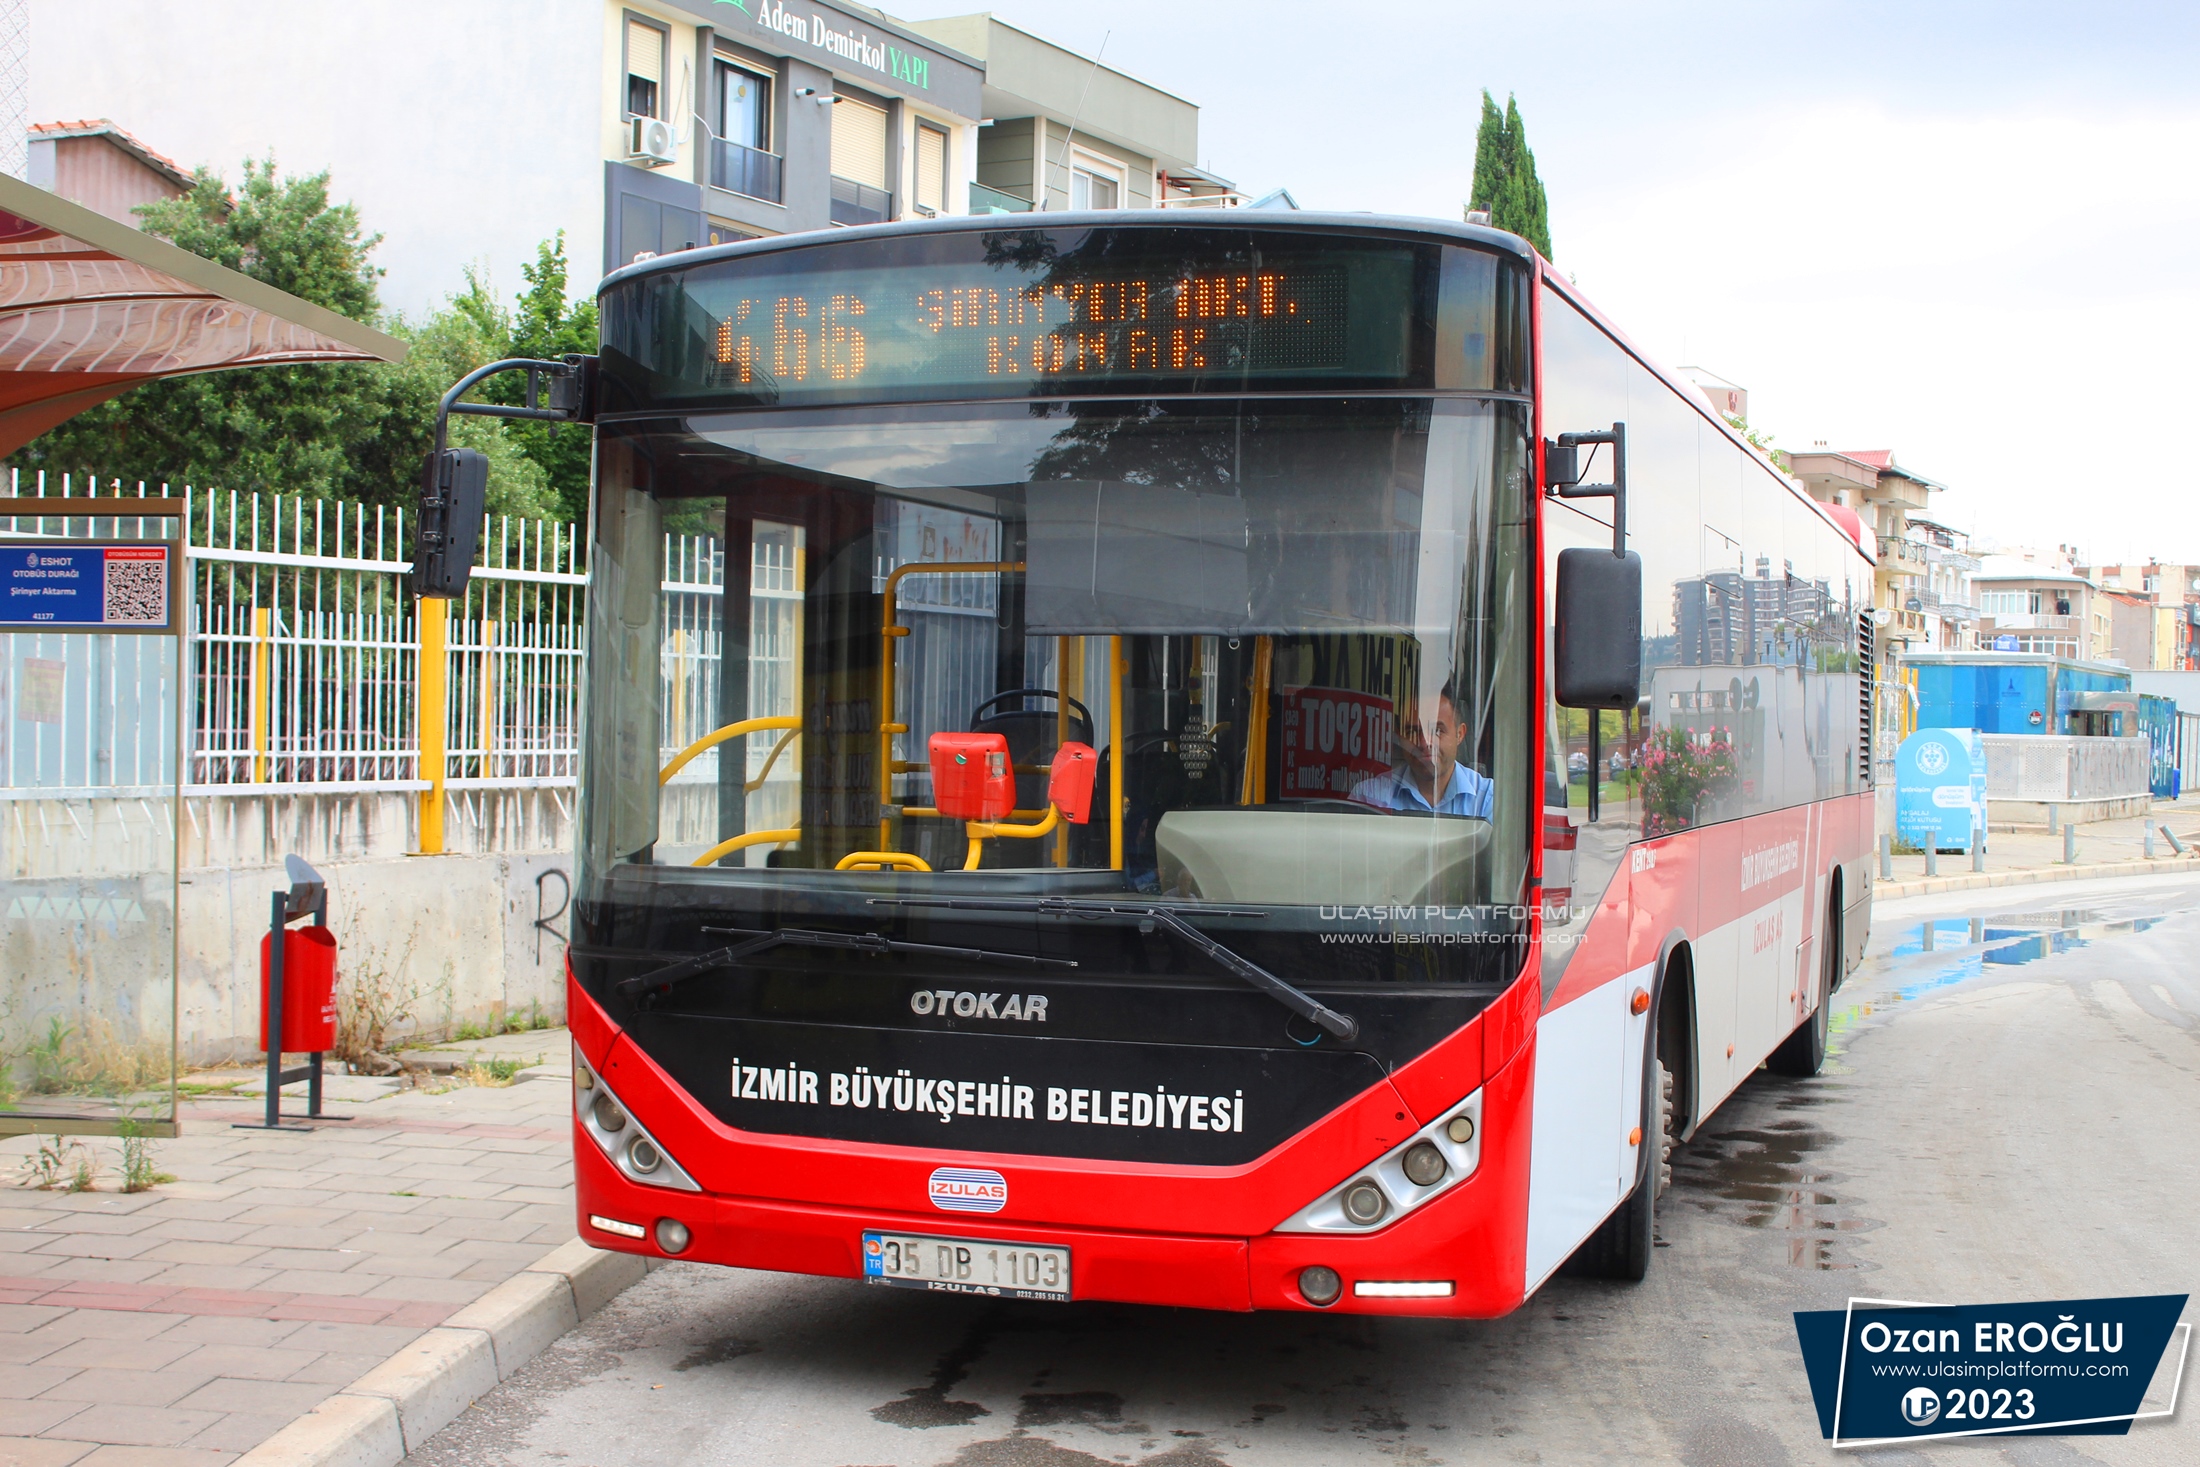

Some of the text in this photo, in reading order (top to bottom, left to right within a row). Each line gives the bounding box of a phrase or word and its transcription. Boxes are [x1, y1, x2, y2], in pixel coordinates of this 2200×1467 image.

[758, 0, 929, 90] Adem Demirkol YAPI
[717, 294, 866, 384] 466
[988, 327, 1206, 374] KONAK
[12, 568, 79, 578] OTOBÜS DURAĞI
[40, 557, 73, 566] ESHOT
[10, 586, 77, 597] Şirinyer Aktarma
[32, 612, 54, 620] 41177
[1632, 848, 1647, 875] KENT
[910, 990, 1048, 1022] OTOKAR
[731, 1057, 1244, 1133] İZMİR BÜYÜKŞEHİR BELEDİYESİ
[868, 1258, 882, 1270] TR
[885, 1241, 1060, 1287] 35 DB 1103
